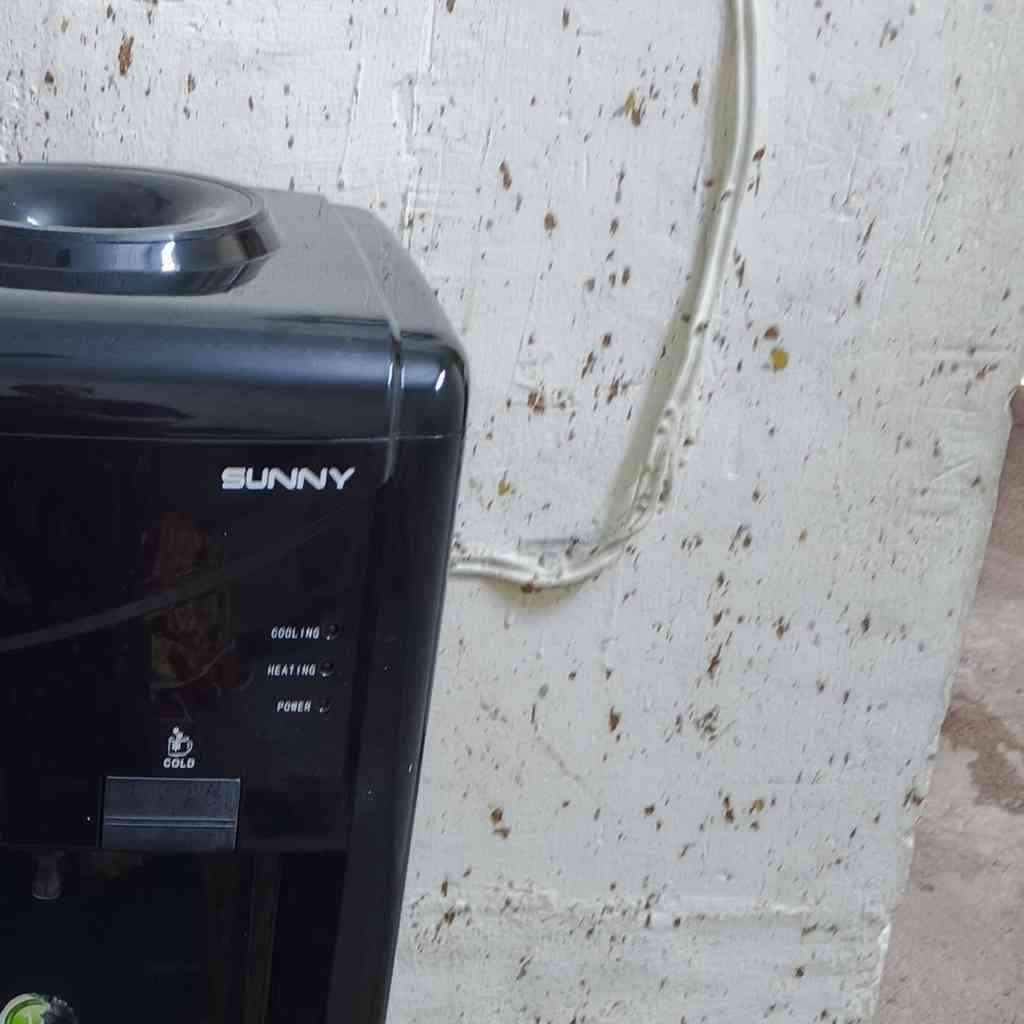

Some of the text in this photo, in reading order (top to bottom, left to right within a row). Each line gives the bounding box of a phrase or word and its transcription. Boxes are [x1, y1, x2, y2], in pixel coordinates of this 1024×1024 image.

[221, 466, 356, 490] SUNNY
[270, 627, 320, 639] COOLING
[267, 664, 316, 677] HEATING
[276, 701, 312, 713] POWER
[163, 757, 195, 769] COLD
